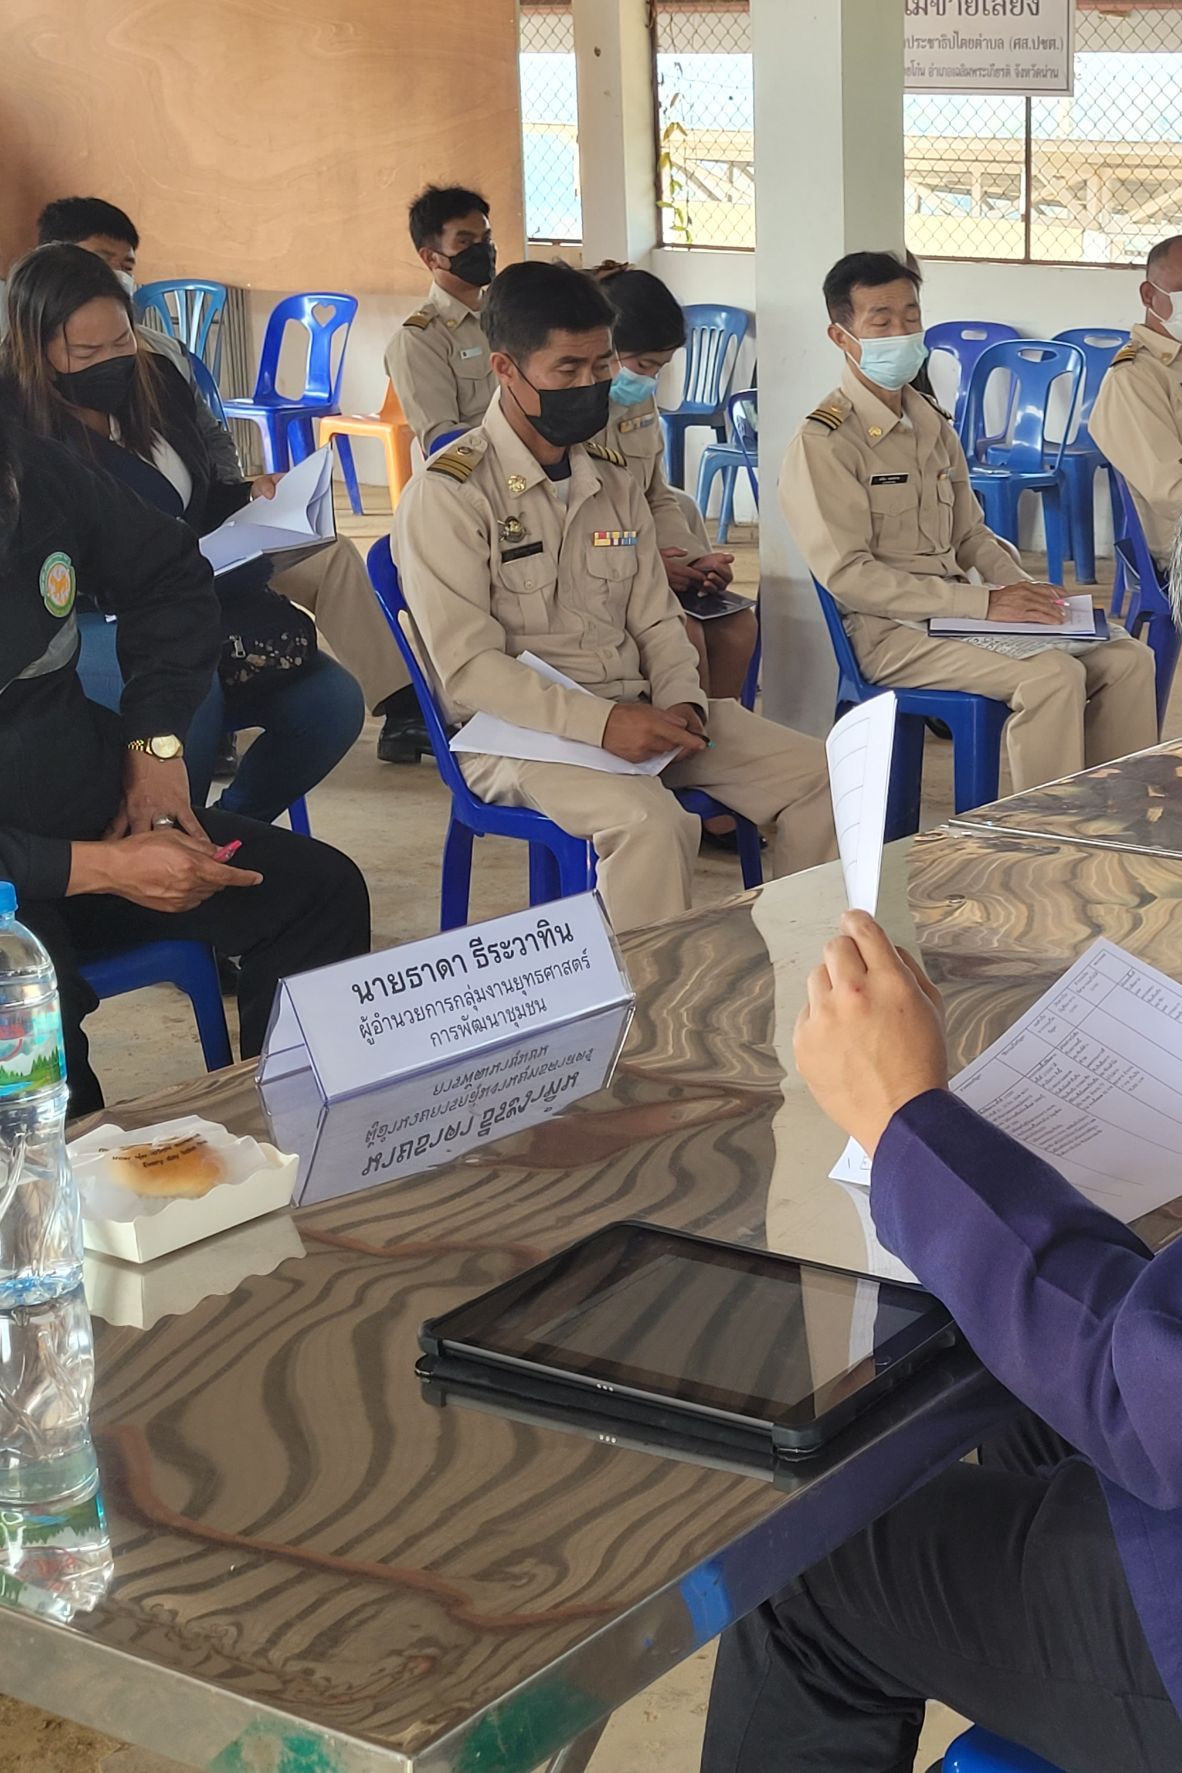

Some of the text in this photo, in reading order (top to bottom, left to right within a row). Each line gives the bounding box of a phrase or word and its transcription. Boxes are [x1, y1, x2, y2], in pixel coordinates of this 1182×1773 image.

[903, 31, 1005, 51] ประชาธิปไตยตำบล
[351, 918, 575, 1004] นายธาดา ธีระวาทิน
[359, 948, 592, 1046] ผู้อำนวยการกลุ่มงานยุทธศาสตร์
[430, 998, 548, 1047] การพัฒนาชุมชน
